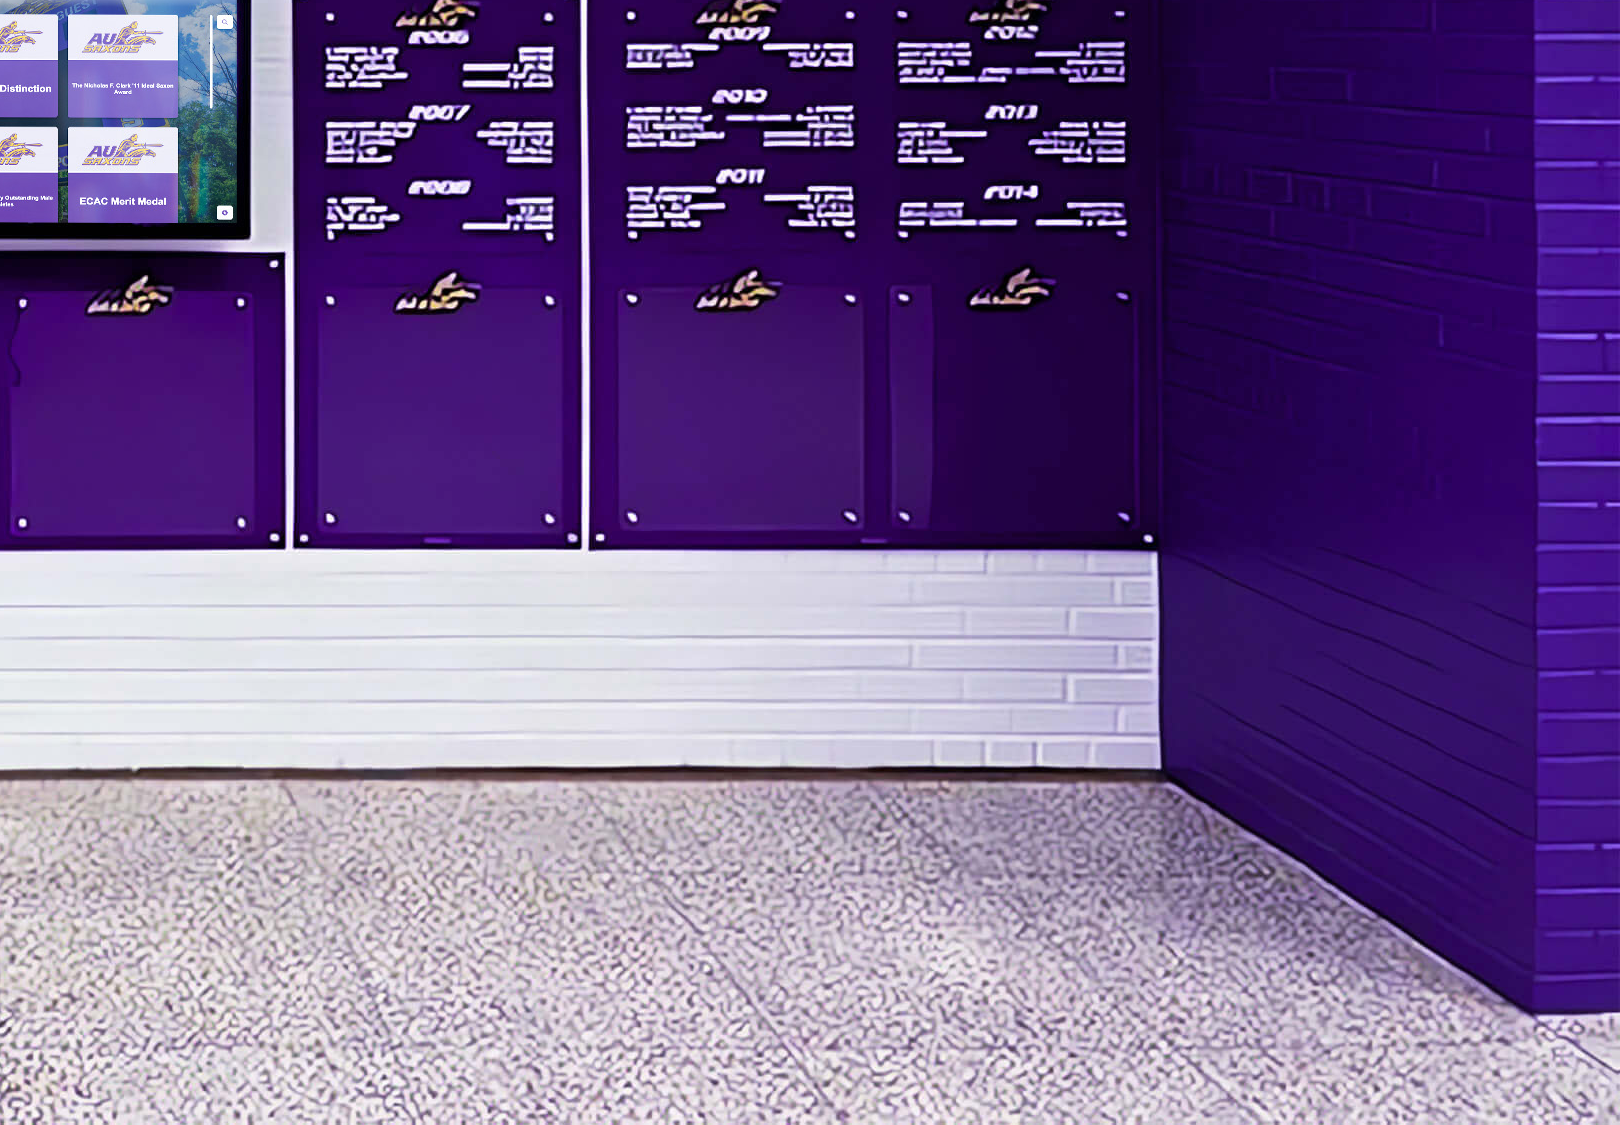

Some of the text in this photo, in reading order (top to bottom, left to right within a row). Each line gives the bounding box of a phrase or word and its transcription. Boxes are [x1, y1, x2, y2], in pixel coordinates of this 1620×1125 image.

[87, 33, 117, 45] AU
[82, 45, 141, 53] SAXONS
[0, 84, 52, 93] Distinction
[87, 145, 117, 157] AU
[82, 157, 141, 165] SAXONS
[79, 197, 167, 205] ECAC Merit Medal
